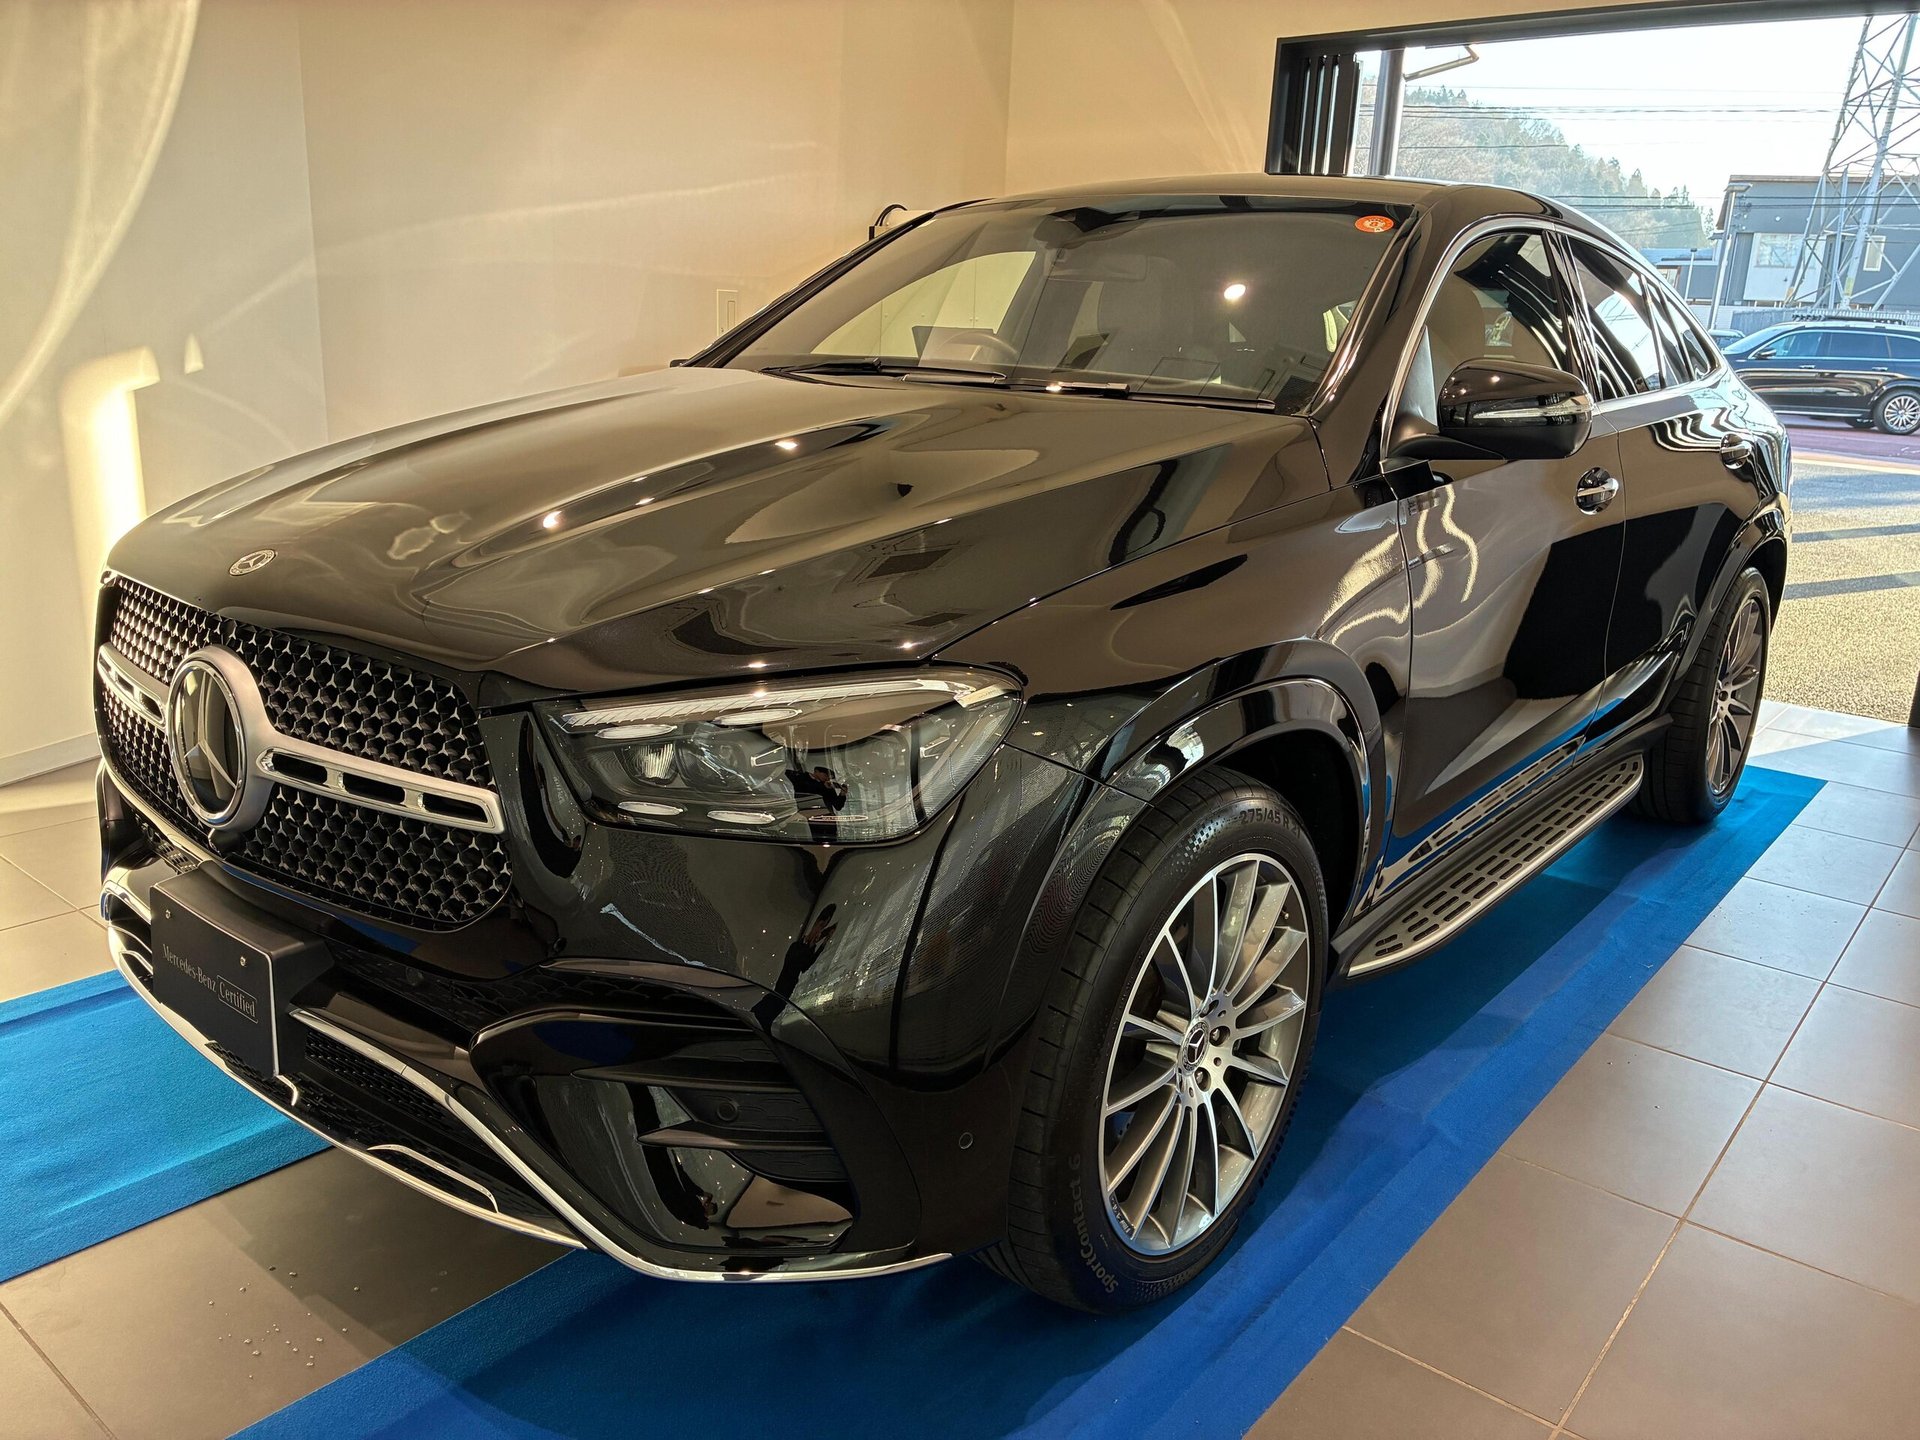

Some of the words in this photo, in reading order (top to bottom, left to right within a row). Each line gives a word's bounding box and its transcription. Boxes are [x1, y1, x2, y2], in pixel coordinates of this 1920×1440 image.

[1240, 808, 1281, 824] 275/45
[1282, 814, 1290, 830] R
[162, 943, 217, 993] Mercedes-Benz
[219, 981, 256, 1018] Certified
[1069, 1175, 1119, 1294] SportContact
